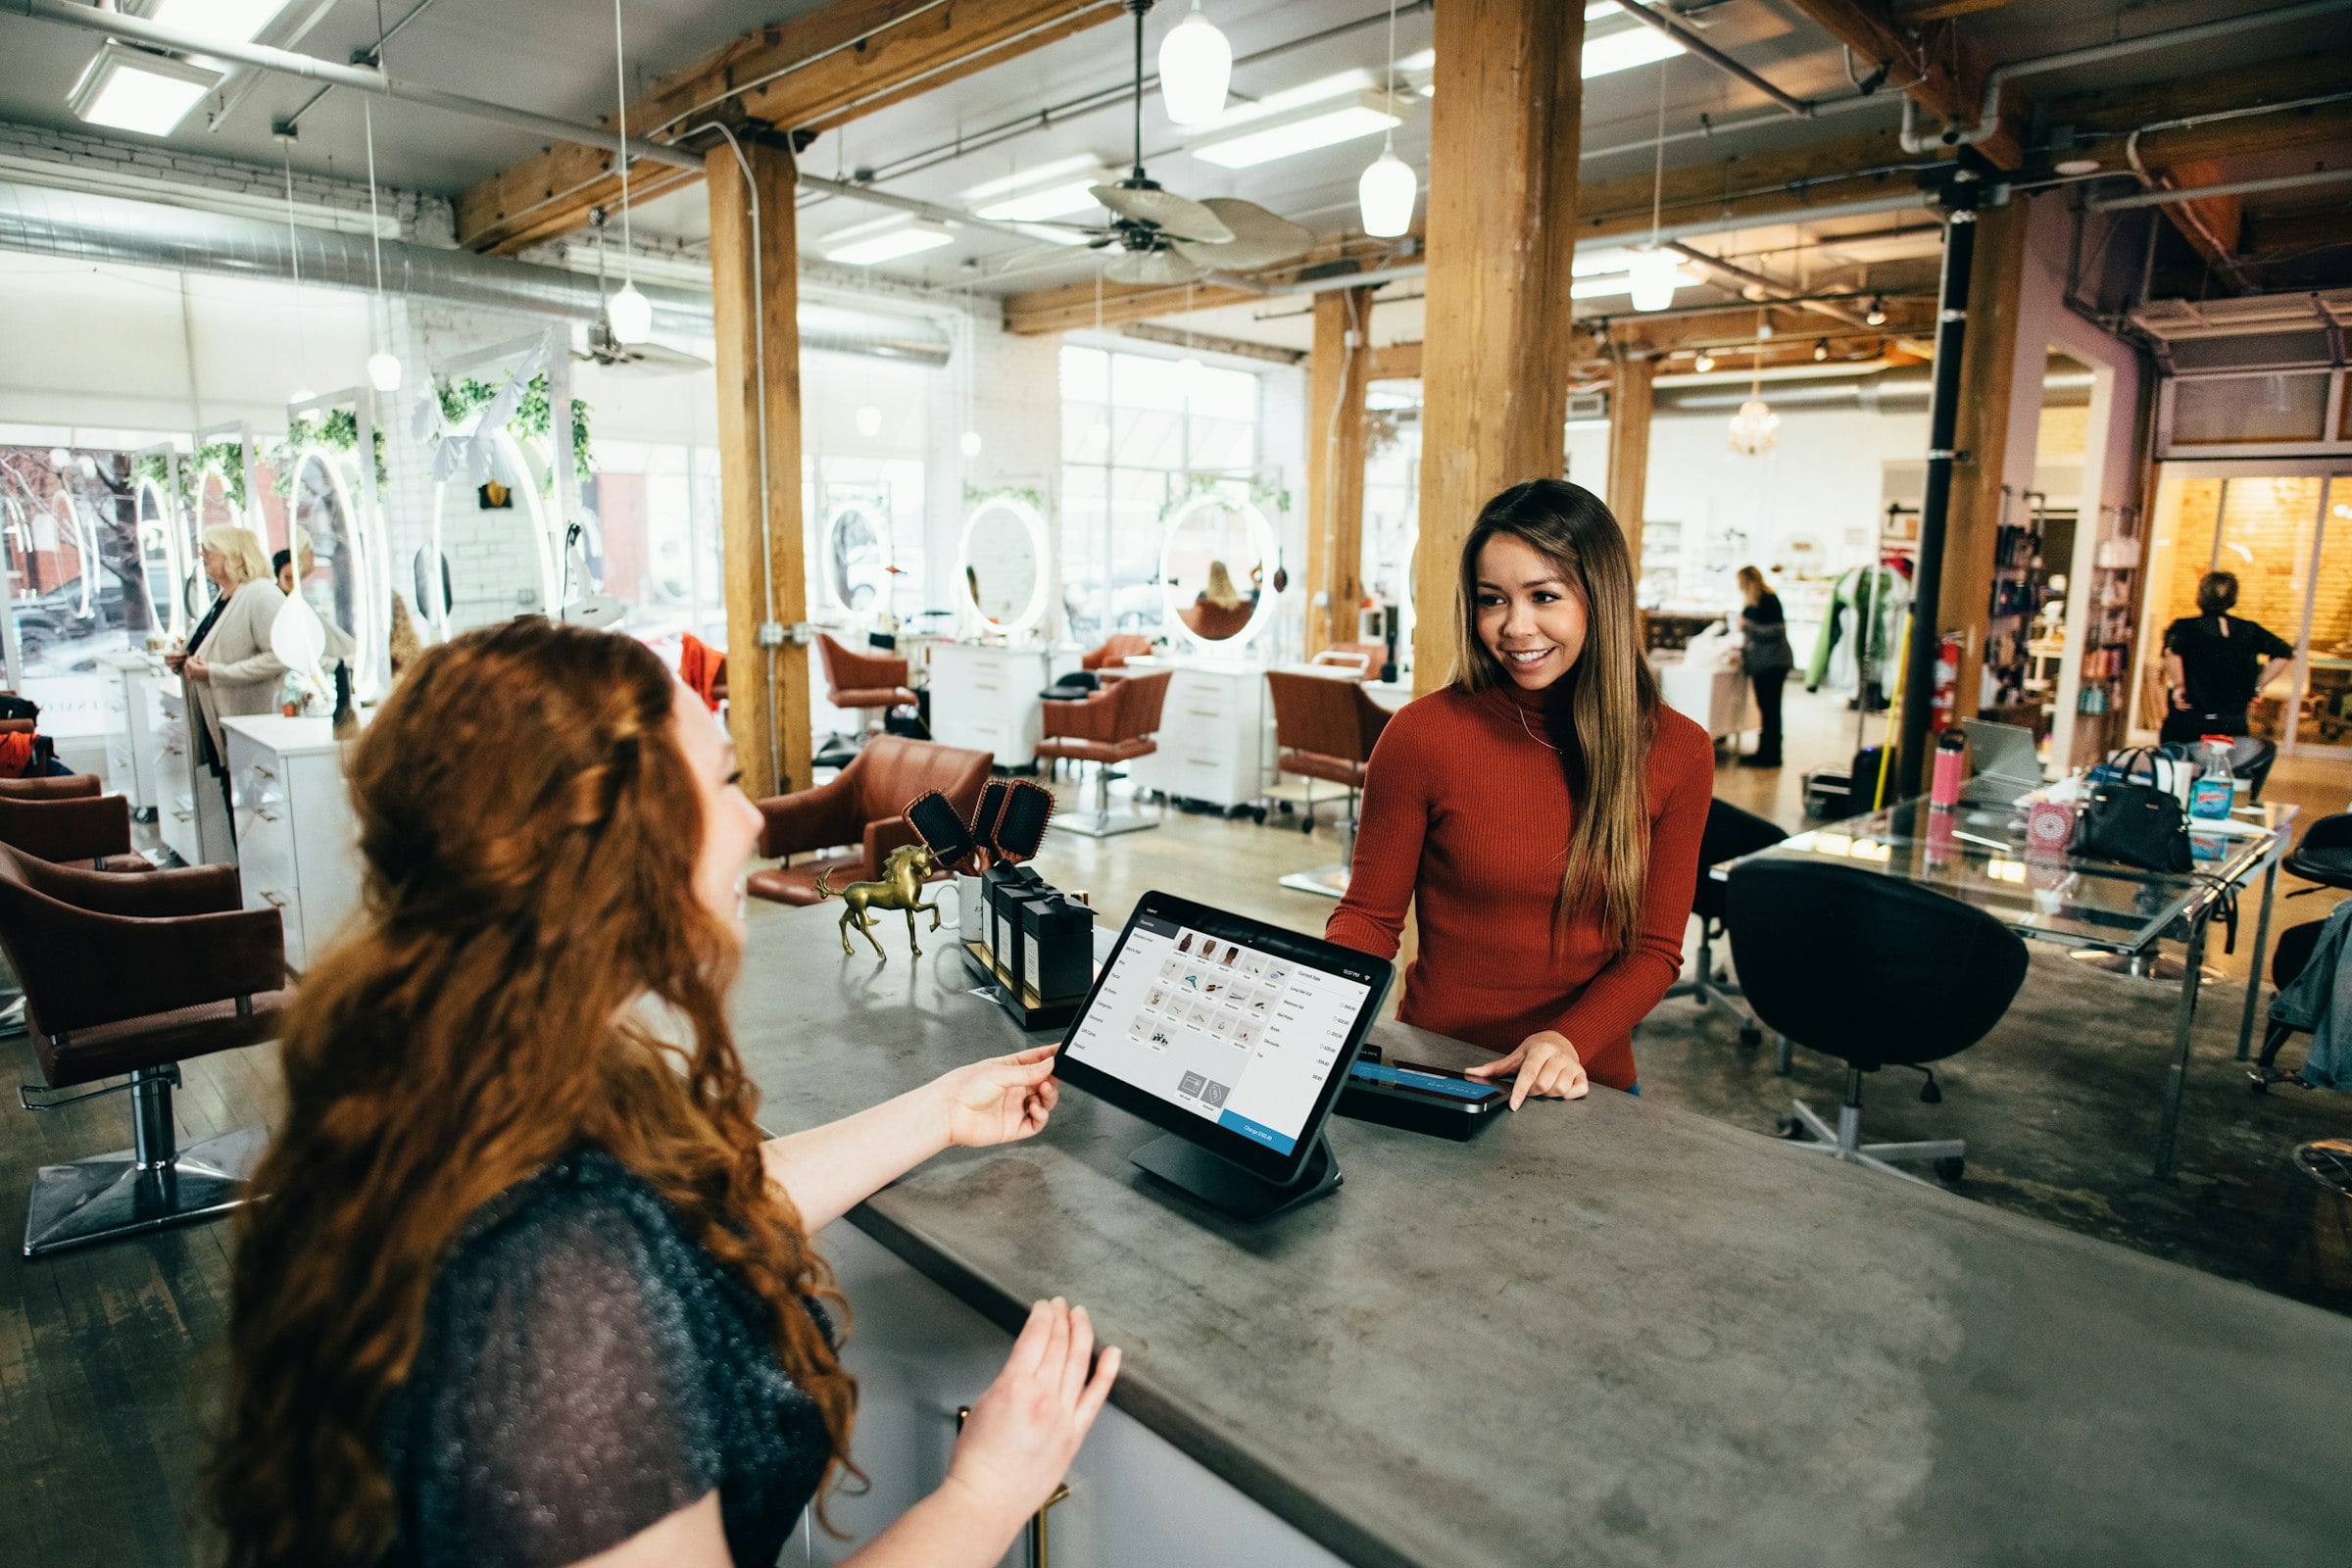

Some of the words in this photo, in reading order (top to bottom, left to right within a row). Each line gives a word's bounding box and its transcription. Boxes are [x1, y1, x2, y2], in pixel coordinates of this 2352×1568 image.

[1298, 970, 1313, 979] Current
[1096, 1001, 1112, 1010] Categories
[1088, 1013, 1103, 1023] Discounts
[1263, 1038, 1280, 1048] Discounts
[1244, 1124, 1258, 1136] Charge
